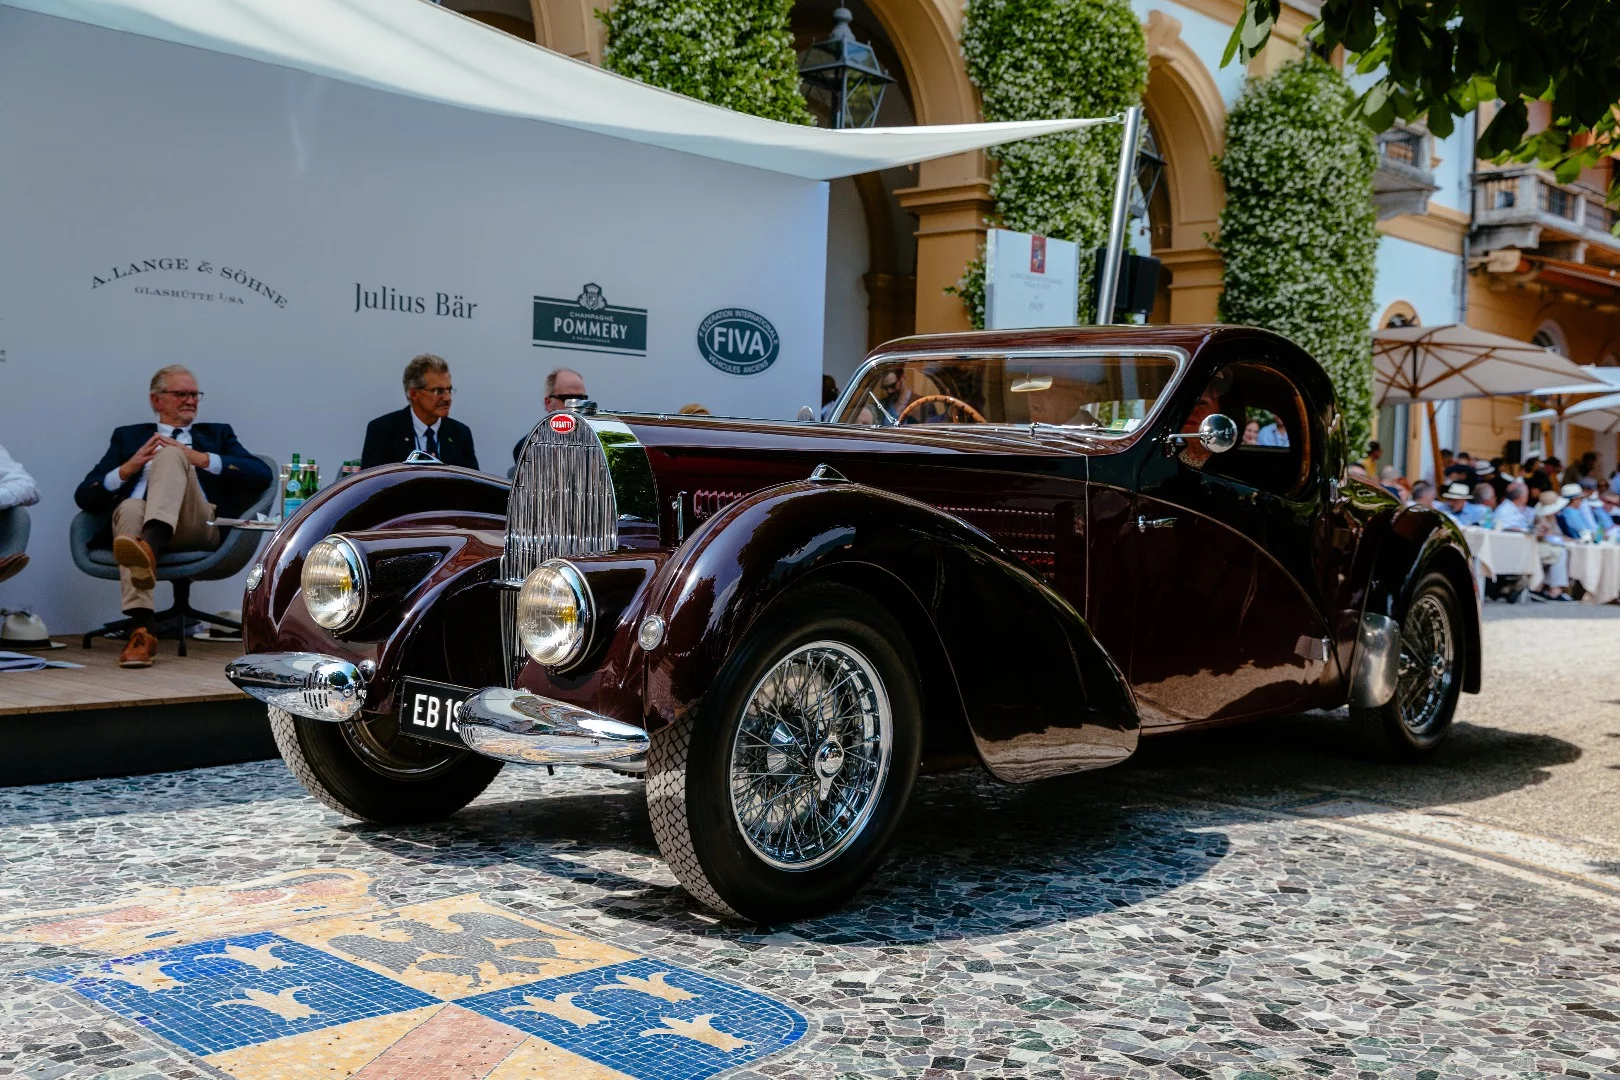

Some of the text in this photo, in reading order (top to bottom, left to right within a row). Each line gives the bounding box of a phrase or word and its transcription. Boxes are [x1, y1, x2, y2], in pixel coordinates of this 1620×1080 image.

[134, 286, 214, 301] GLASHÜTTE
[196, 260, 213, 274] &
[219, 266, 288, 309] SÖHNE
[354, 283, 478, 319] Julius Bär
[553, 317, 627, 340] POMMERY
[569, 312, 614, 323] CHAMPAGNE
[735, 310, 778, 345] INTERNATIONALE
[713, 326, 765, 357] FIVA
[552, 420, 572, 429] BUGATTI
[412, 693, 441, 728] EB
